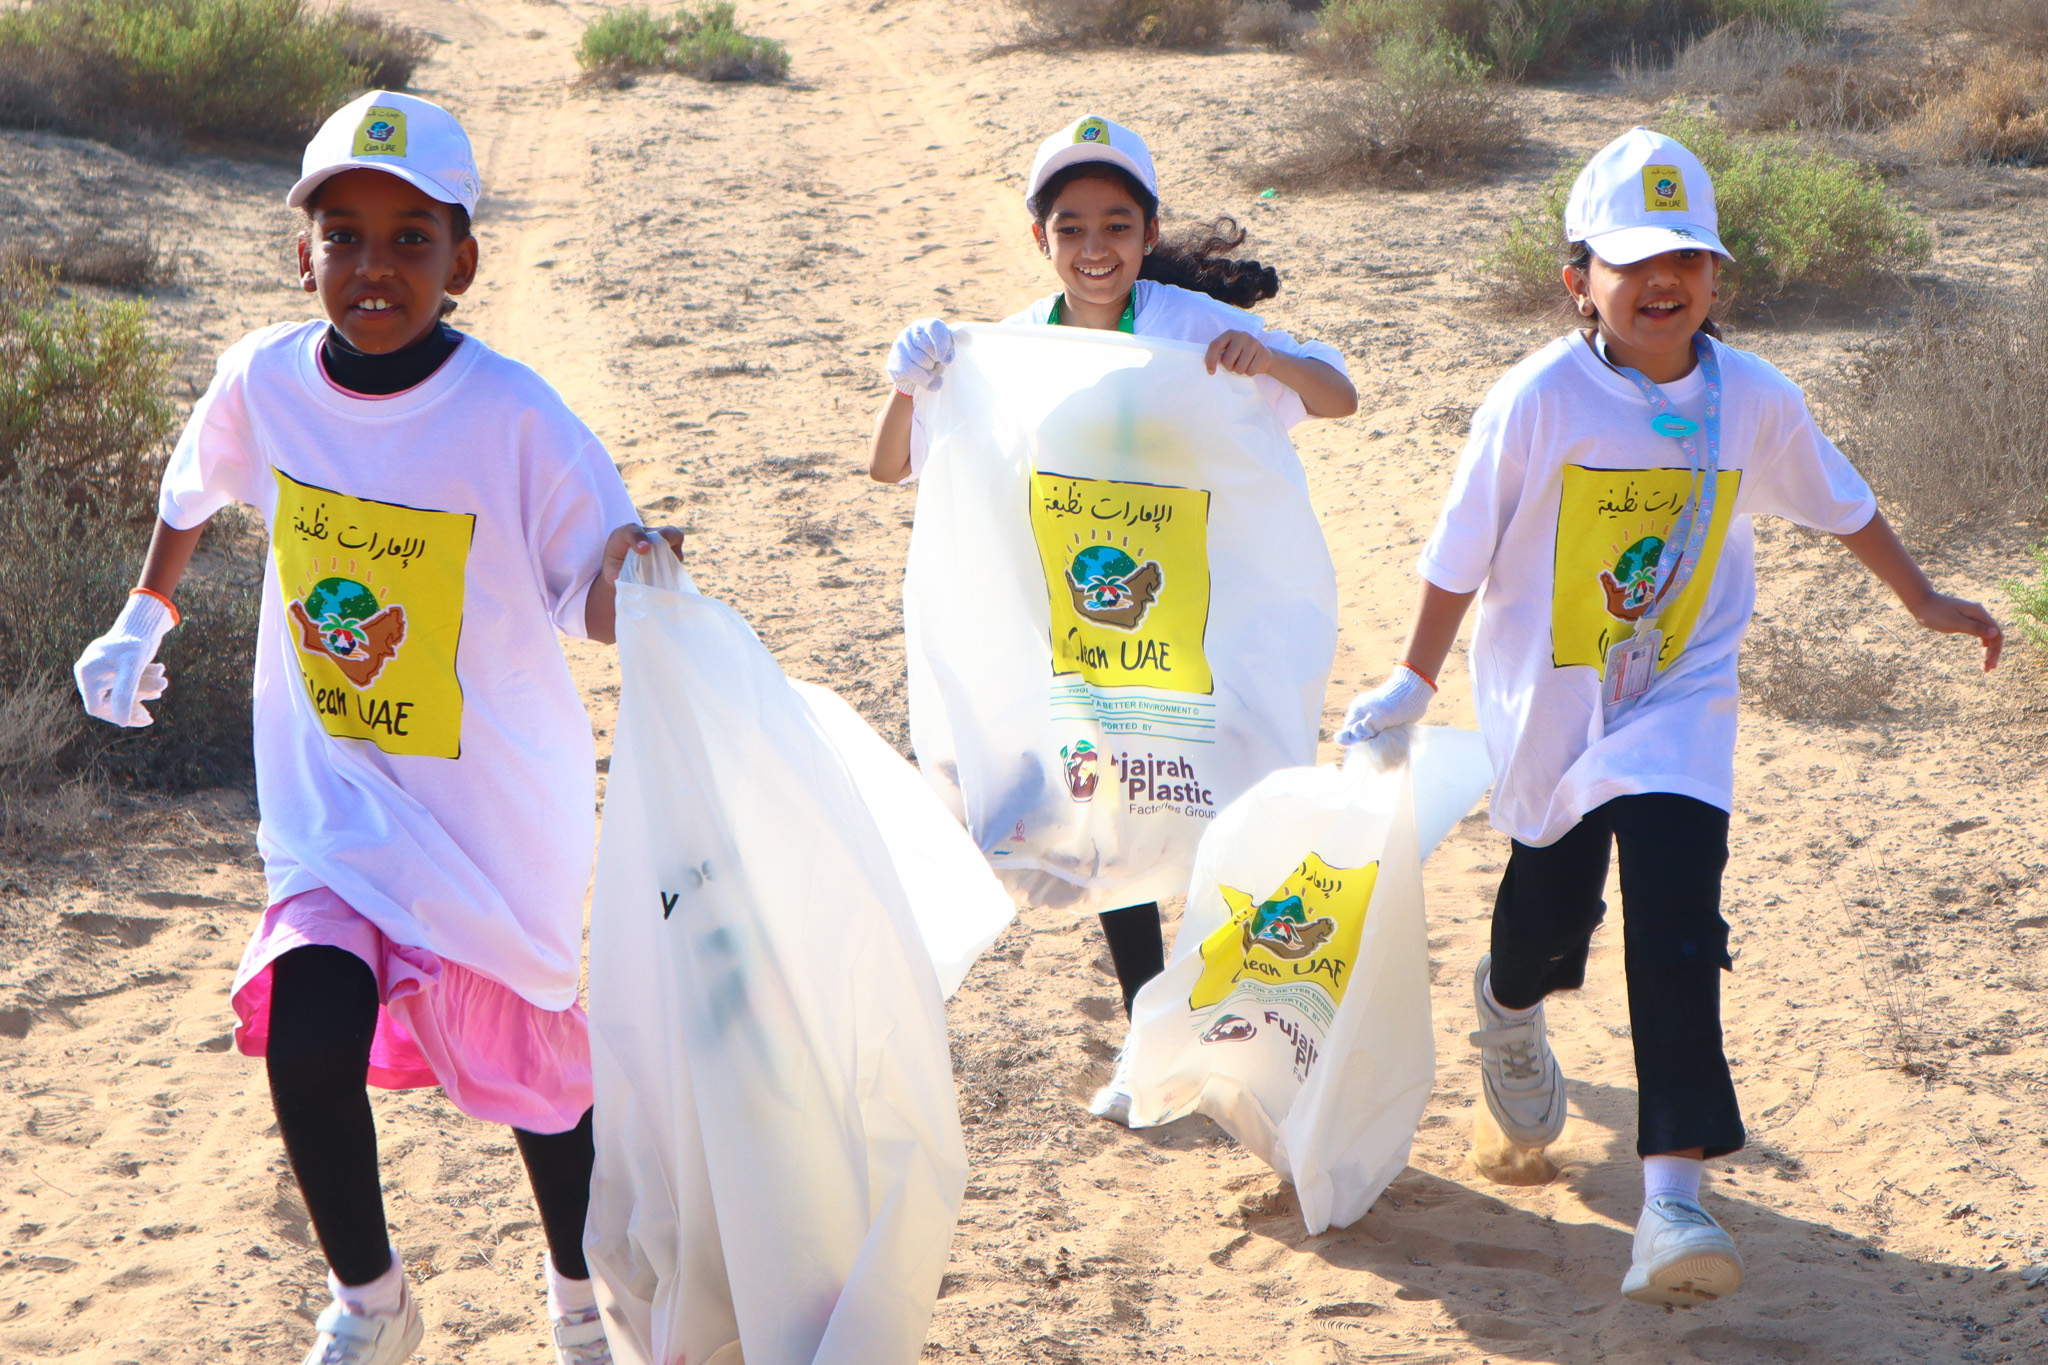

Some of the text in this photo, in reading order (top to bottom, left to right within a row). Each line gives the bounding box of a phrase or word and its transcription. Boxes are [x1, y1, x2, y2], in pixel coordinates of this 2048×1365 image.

[1044, 481, 1173, 533] الإمارات نظيفة
[1598, 480, 1639, 519] نظيفة
[293, 502, 426, 569] الإمارات نظيفة
[1120, 639, 1172, 672] UAE
[357, 693, 415, 737] UAE
[1102, 700, 1137, 710] BETTER
[1138, 701, 1192, 715] ENVIRONMENT
[1142, 723, 1153, 732] BY
[1110, 752, 1195, 783] jairah
[1128, 777, 1214, 806] Plastic
[1129, 802, 1217, 820] Factories Group
